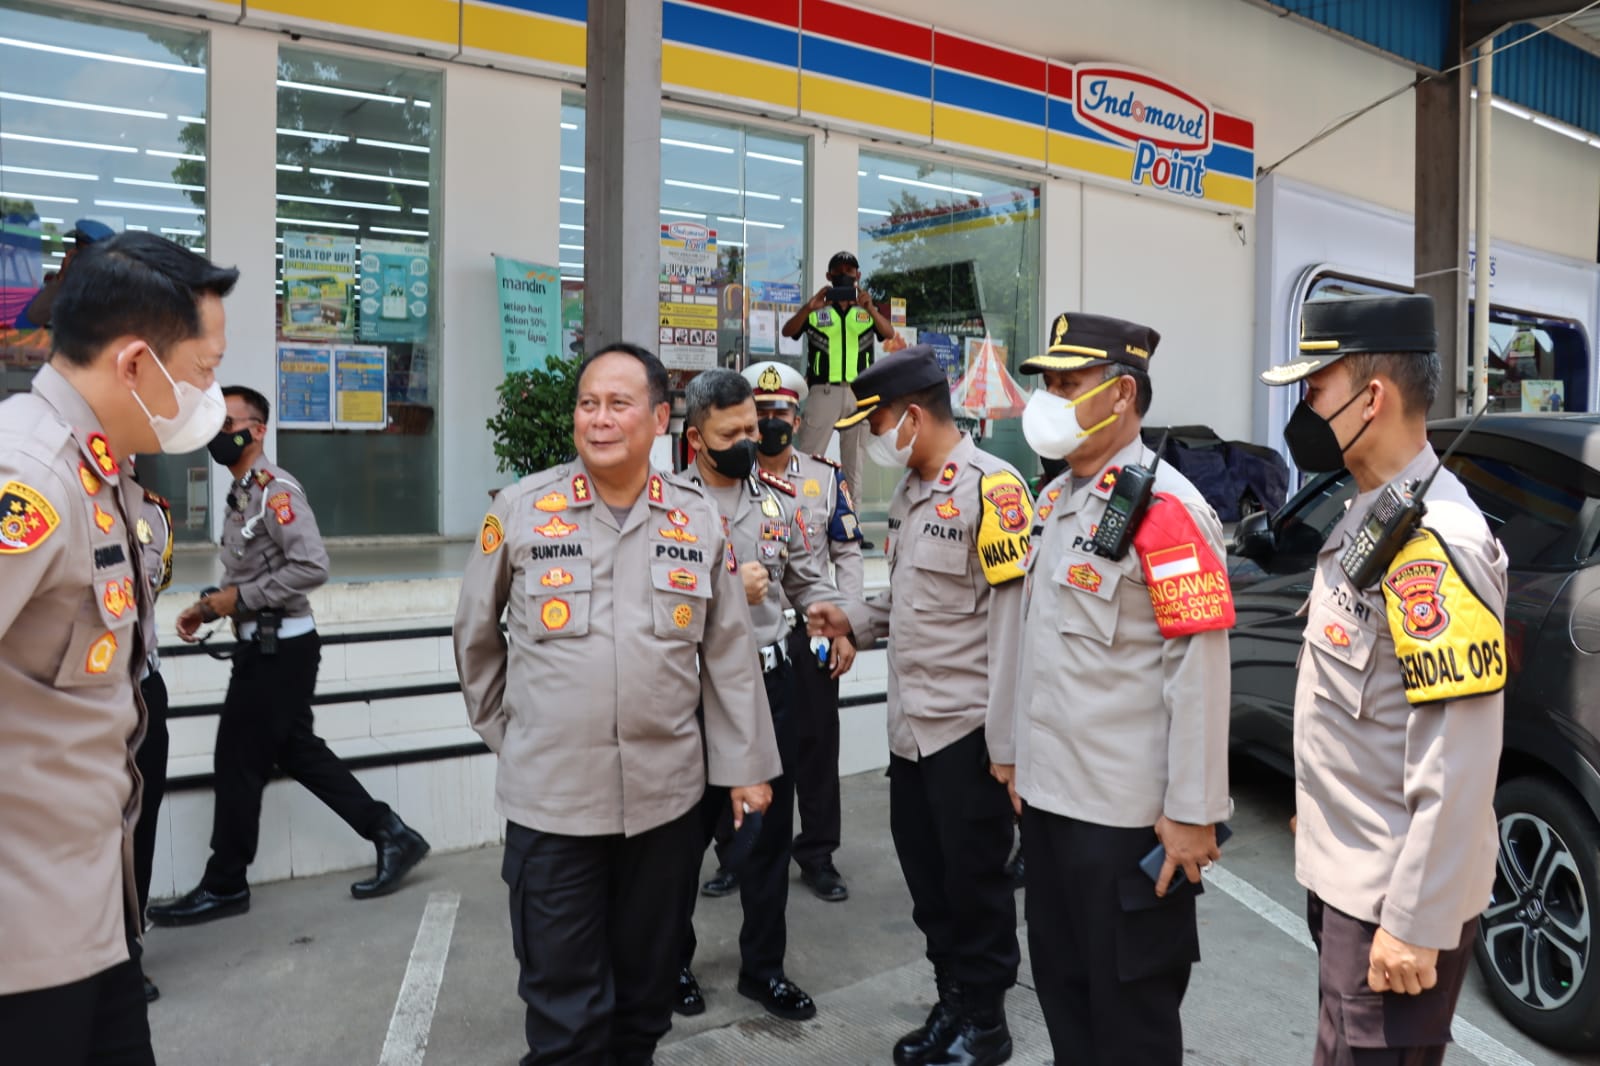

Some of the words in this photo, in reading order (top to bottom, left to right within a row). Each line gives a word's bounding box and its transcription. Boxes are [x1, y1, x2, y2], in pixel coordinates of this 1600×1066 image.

[1084, 80, 1203, 139] Indomaret
[1132, 140, 1205, 196] Point
[288, 248, 313, 259] BISA
[314, 249, 331, 261] TOP
[333, 251, 350, 263] UP!
[503, 301, 527, 314] setiap
[528, 303, 543, 315] hari
[503, 314, 529, 326] diskon
[922, 523, 963, 542] POLRI
[531, 544, 583, 561] SUNTANA
[655, 545, 703, 562] POLRI
[981, 540, 1019, 569] WAKA
[1071, 536, 1105, 557] POL
[1331, 586, 1372, 622] POLRI
[1467, 639, 1504, 680] OPS
